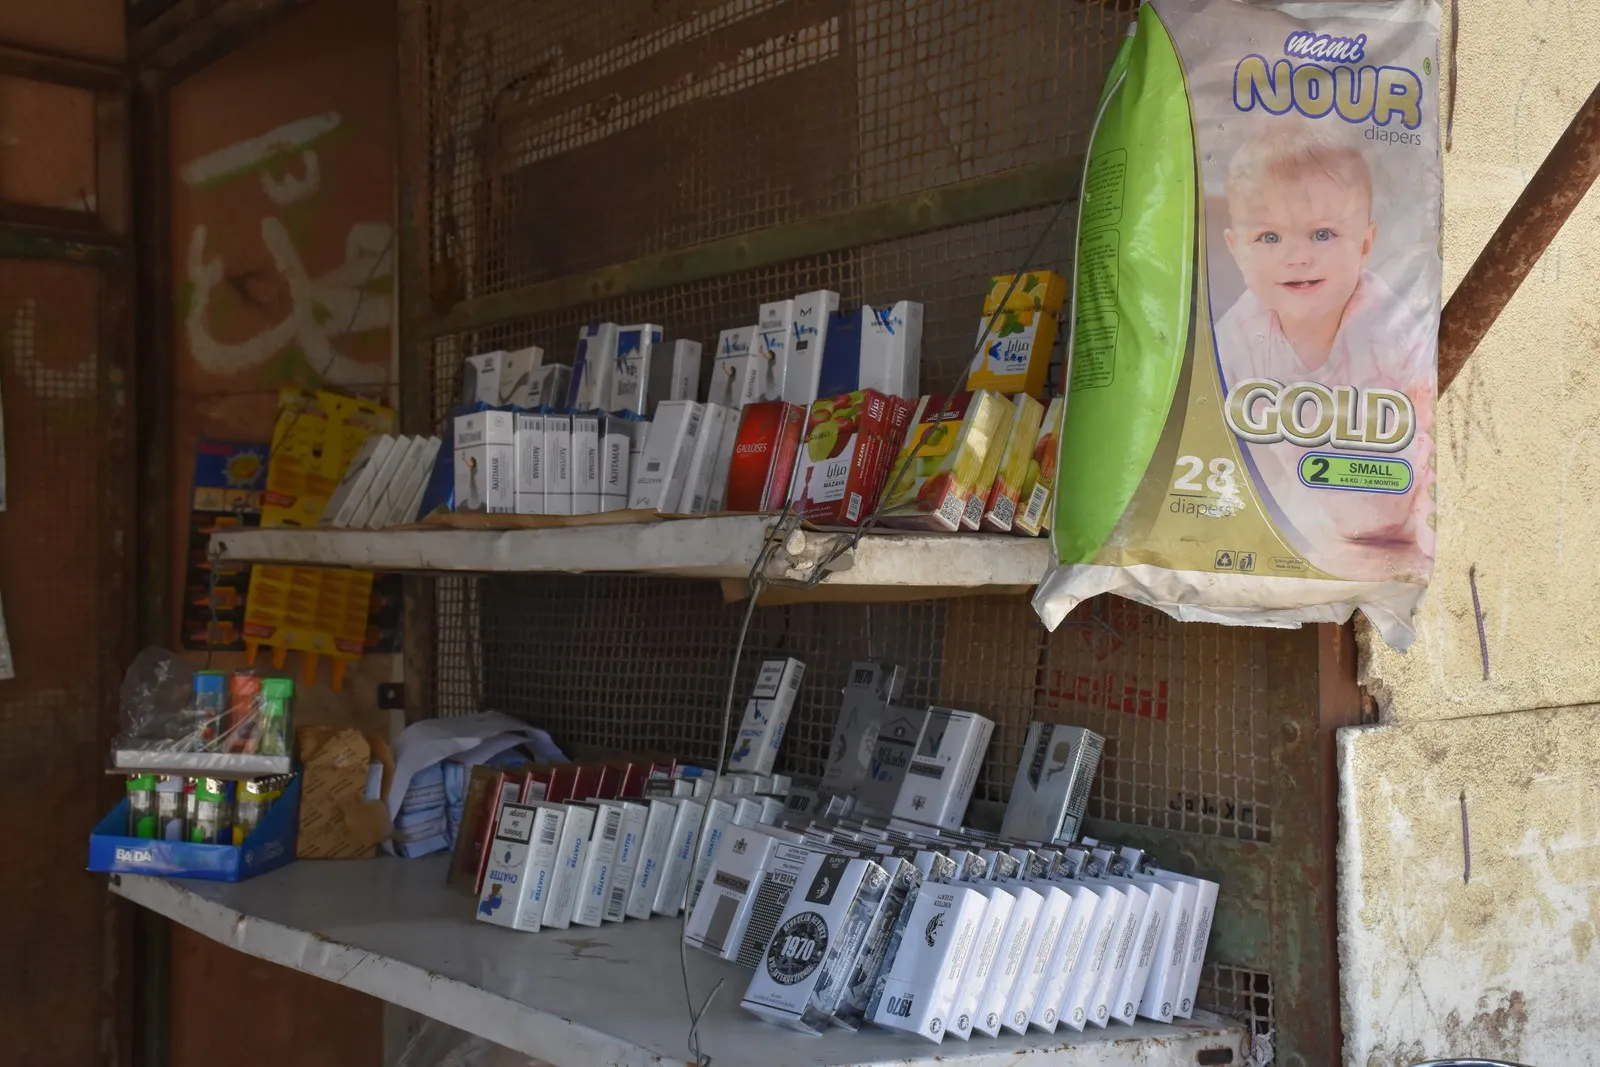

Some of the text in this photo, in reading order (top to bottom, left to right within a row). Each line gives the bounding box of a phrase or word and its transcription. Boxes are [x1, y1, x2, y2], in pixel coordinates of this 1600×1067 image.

[1285, 31, 1366, 63] mami
[1233, 53, 1423, 130] NOUR
[1364, 126, 1421, 146] diapers
[1224, 378, 1416, 452] GOLD
[736, 442, 768, 454] GAULOISES
[827, 463, 847, 480] مزايا
[1174, 455, 1236, 494] 28
[1310, 457, 1330, 483] 2
[1349, 462, 1392, 476] SMALL
[823, 480, 844, 488] MAZAYA
[1170, 497, 1232, 518] diapers
[853, 669, 874, 686] 1970
[1032, 725, 1052, 776] SELFIE
[790, 794, 809, 811] 1970
[570, 838, 582, 868] CHATTER
[621, 833, 633, 863] CHATTER
[489, 870, 518, 884] CHATTER
[534, 870, 545, 901] CHATTER
[596, 866, 608, 897] CHATTER
[715, 874, 748, 889] KINGDOM
[937, 894, 954, 902] SEVENTY
[781, 935, 816, 961] 1970
[886, 996, 913, 1018] 1970
